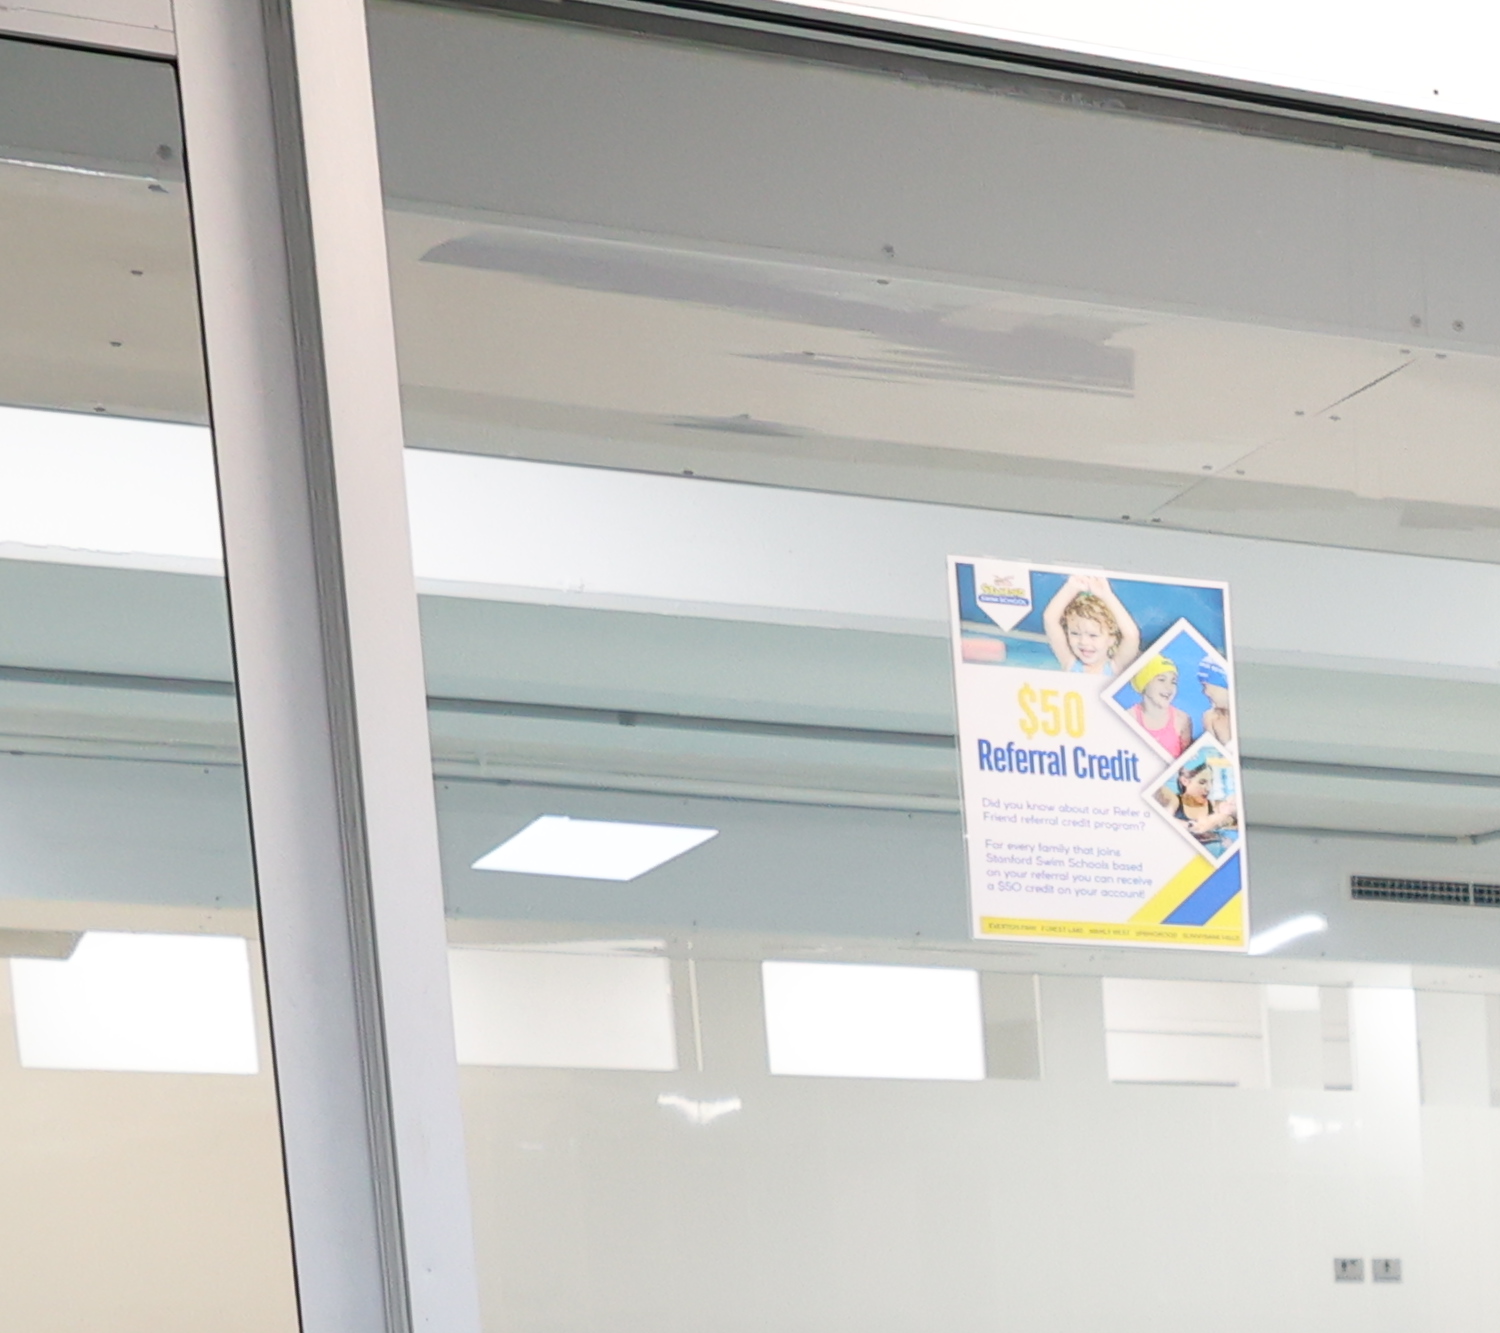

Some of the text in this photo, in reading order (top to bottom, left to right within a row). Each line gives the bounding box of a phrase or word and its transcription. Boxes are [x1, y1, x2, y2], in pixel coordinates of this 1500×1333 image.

[1017, 682, 1085, 740] $50
[977, 738, 1141, 783] Referral Credit
[982, 798, 1150, 818] Did you know about our Refer a
[983, 812, 1145, 831] Friend referral credit program?
[985, 839, 1120, 857] For every family that joins
[986, 853, 1143, 872] Stanford Swim Schools based
[1004, 870, 1027, 880] your
[1031, 870, 1069, 881] referral
[1072, 875, 1091, 883] you
[1117, 876, 1152, 886] receive
[987, 883, 994, 891] a
[997, 881, 1022, 892] $50
[1025, 884, 1054, 894] credit
[1074, 887, 1097, 897] your
[1100, 889, 1145, 899] account!
